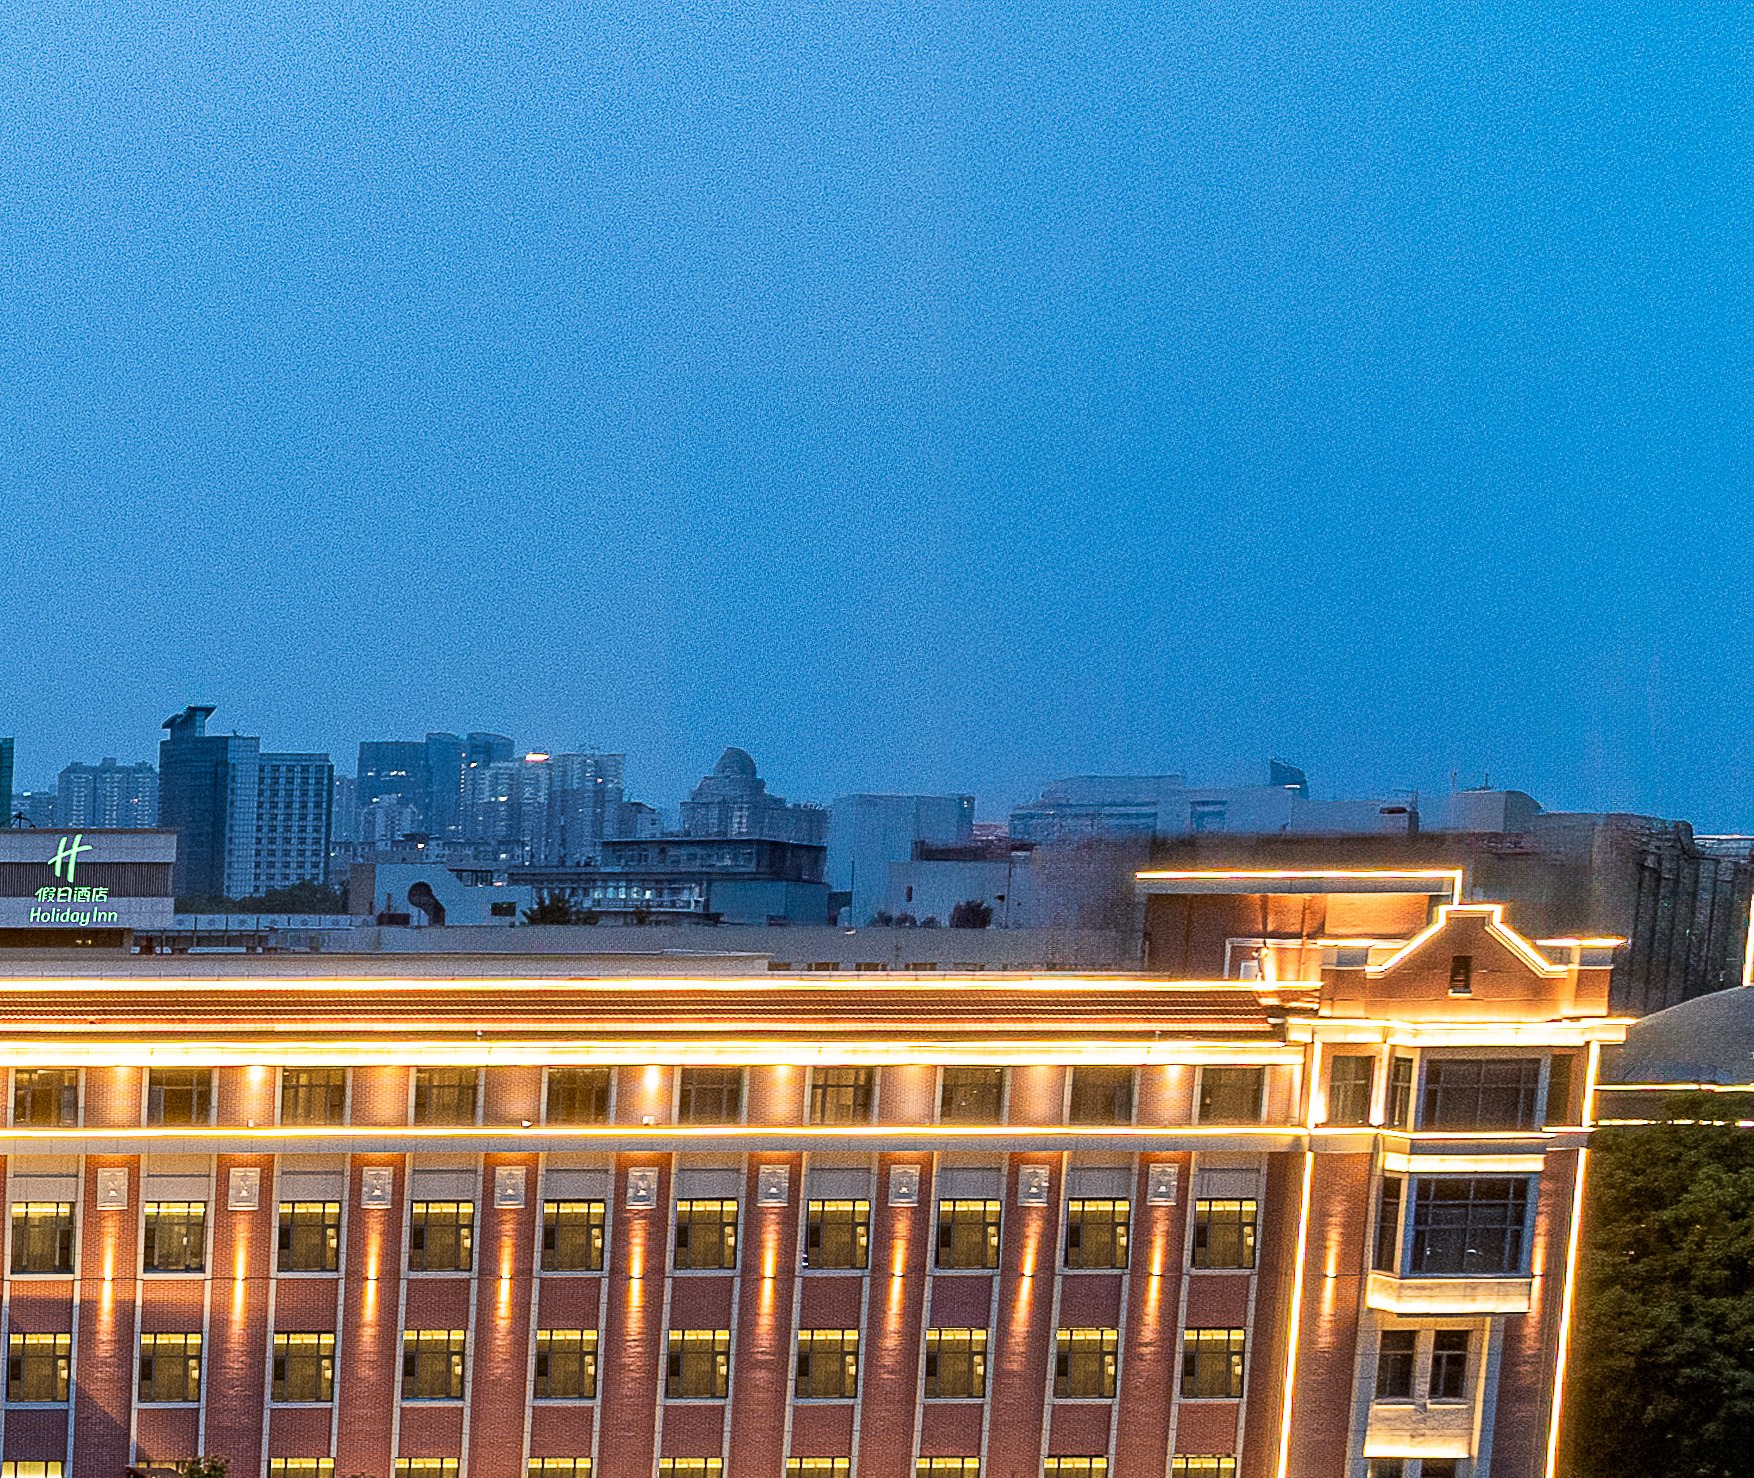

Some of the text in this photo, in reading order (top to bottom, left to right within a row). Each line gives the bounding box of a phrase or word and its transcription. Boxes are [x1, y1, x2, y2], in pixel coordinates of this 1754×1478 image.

[34, 886, 109, 903] 假日酒店
[29, 906, 118, 927] Holiday Inn
